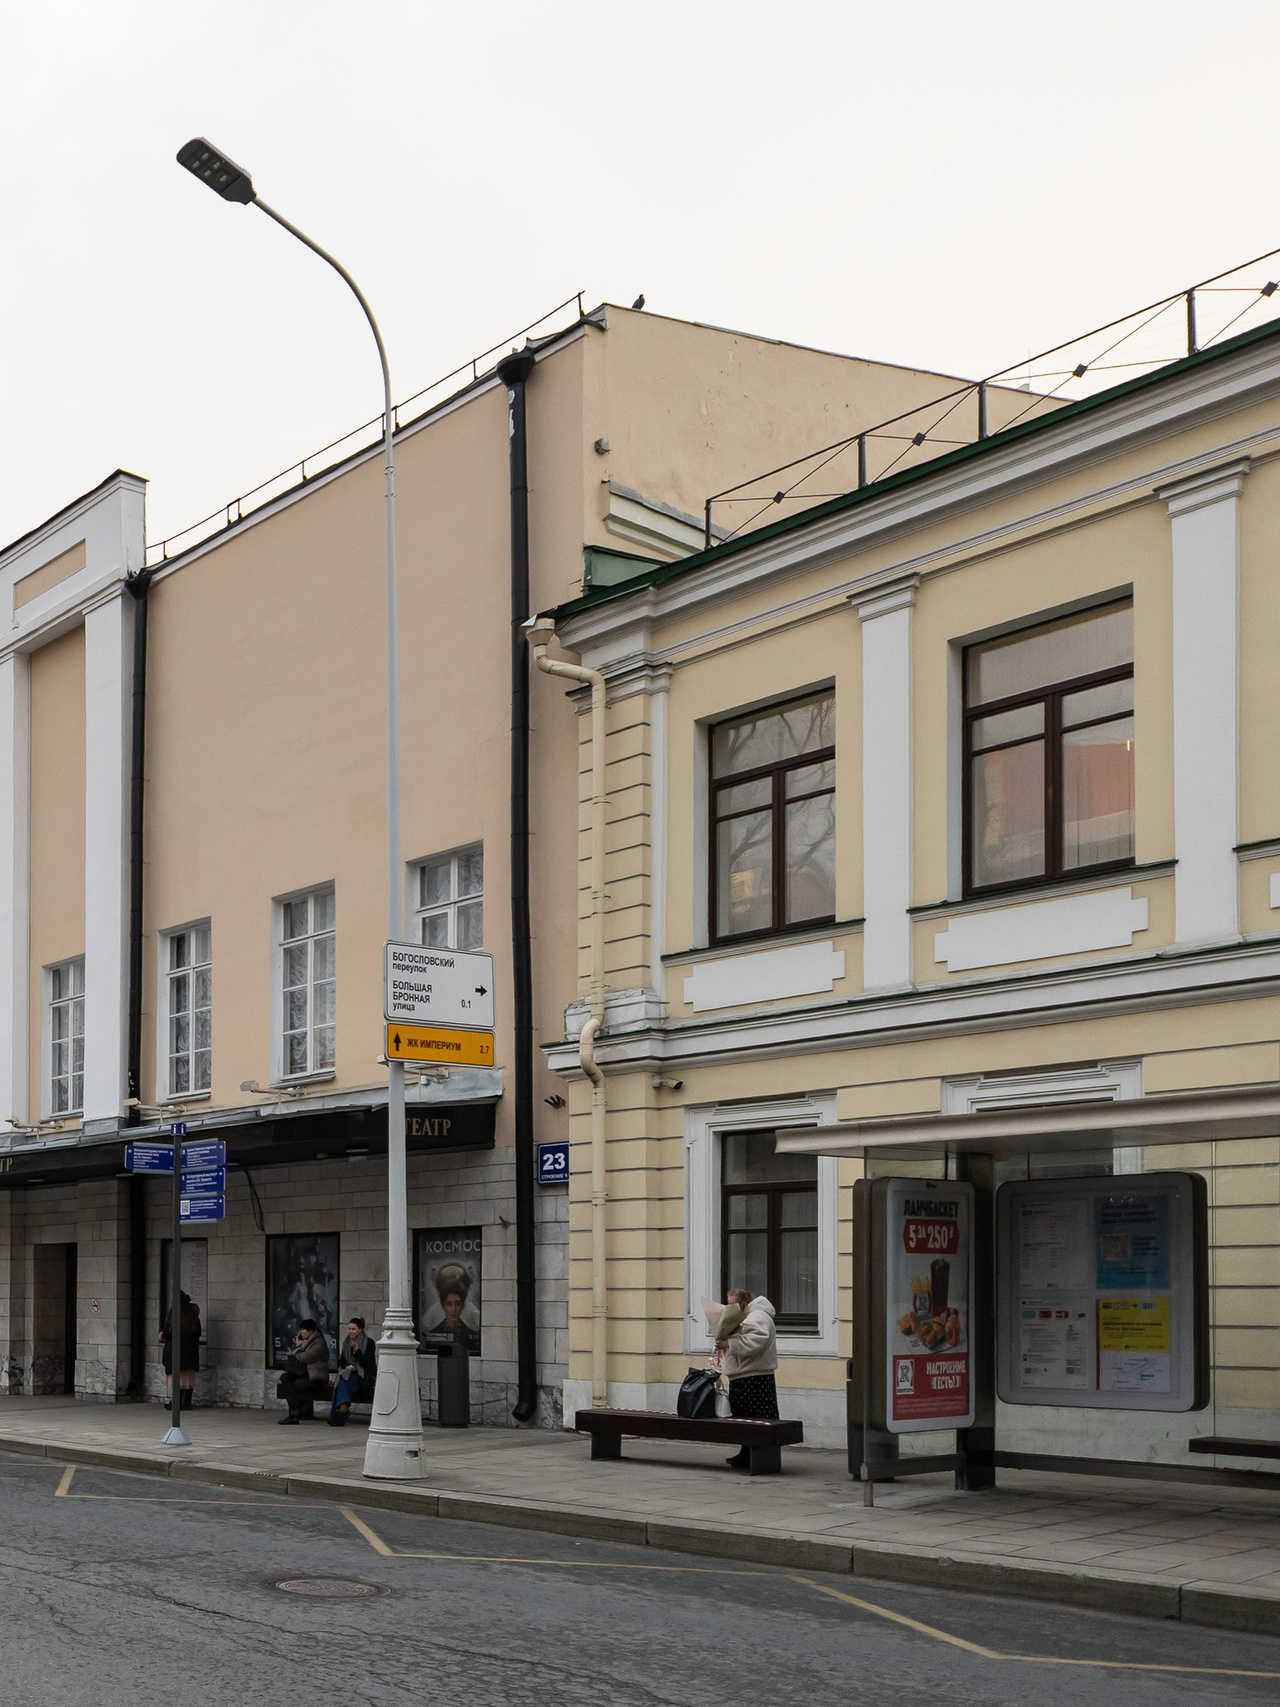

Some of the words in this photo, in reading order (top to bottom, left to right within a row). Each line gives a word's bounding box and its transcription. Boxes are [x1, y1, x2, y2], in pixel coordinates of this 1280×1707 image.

[392, 951, 455, 968] БОГОСЛОВСКИЙ
[392, 963, 427, 974] переулок
[392, 980, 433, 993] БОЛЬШАЯ
[392, 991, 430, 1004] БРОННАЯ
[392, 1002, 416, 1012] улица
[461, 999, 472, 1009] 0.1
[406, 1038, 419, 1048] ЖК
[420, 1039, 462, 1051] ИМПЕРИУМ
[479, 1045, 490, 1054] 2.7
[405, 1117, 452, 1136] ТЕАТР
[542, 1152, 566, 1170] 23
[903, 1199, 959, 1218] ЛАНЧБАСКЕТ
[909, 1224, 916, 1248] 5
[425, 1239, 481, 1253] КОСМОС
[926, 1360, 966, 1375] НАСТРОЕНИЕ
